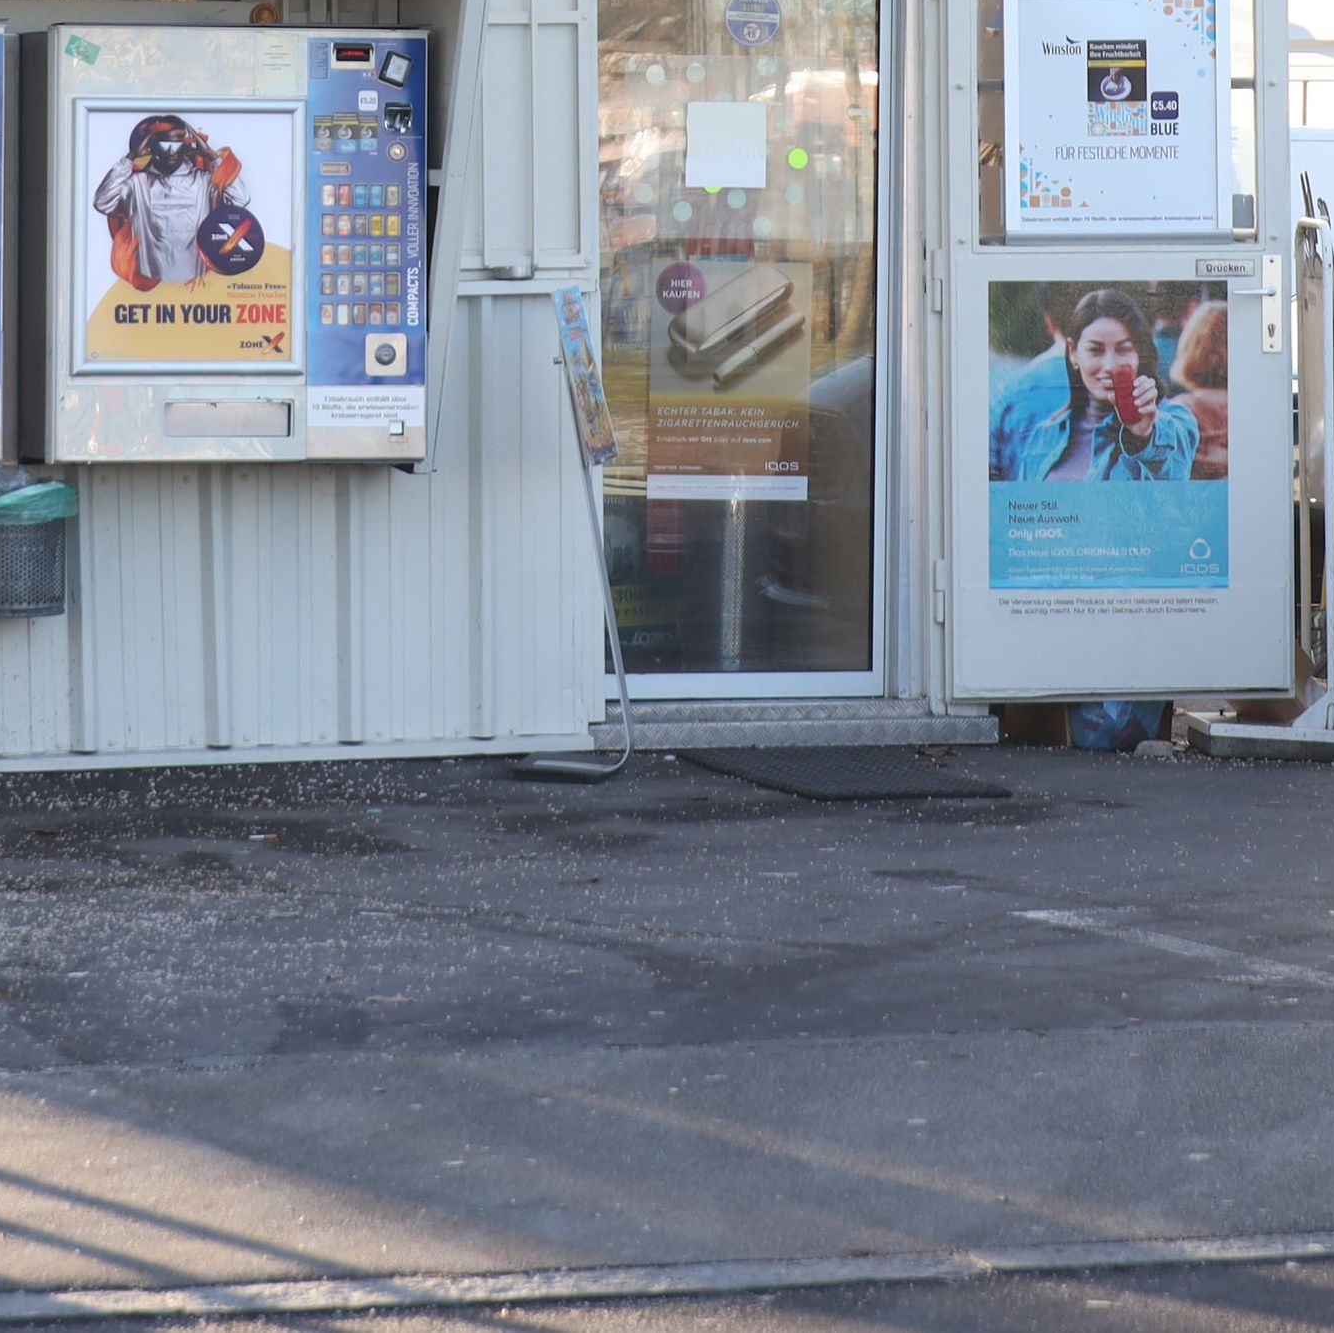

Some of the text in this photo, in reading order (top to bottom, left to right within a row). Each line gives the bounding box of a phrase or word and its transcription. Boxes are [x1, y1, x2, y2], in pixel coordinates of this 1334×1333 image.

[1042, 41, 1082, 56] Winston
[1152, 100, 1178, 111] €5.40
[1150, 122, 1180, 136] BLUE
[1055, 144, 1180, 160] FÜR FESTLICHE MOMENTE
[211, 232, 229, 241] ZONE
[1205, 263, 1246, 273] Drücken
[670, 279, 693, 288] HIER
[662, 290, 701, 299] KAUFEN
[114, 303, 287, 324] GET IN YOUR ZONE
[239, 340, 264, 349] ZONE
[657, 406, 698, 416] ECHTER
[740, 407, 765, 416] KEIN
[656, 418, 801, 429] ZIGARETTENRAUCHGERUCH.
[764, 461, 800, 472] IQOS
[1008, 501, 1039, 511] Neuer
[1008, 515, 1035, 524] Neue
[1008, 528, 1033, 541] Only
[1180, 563, 1220, 576] IQOS
